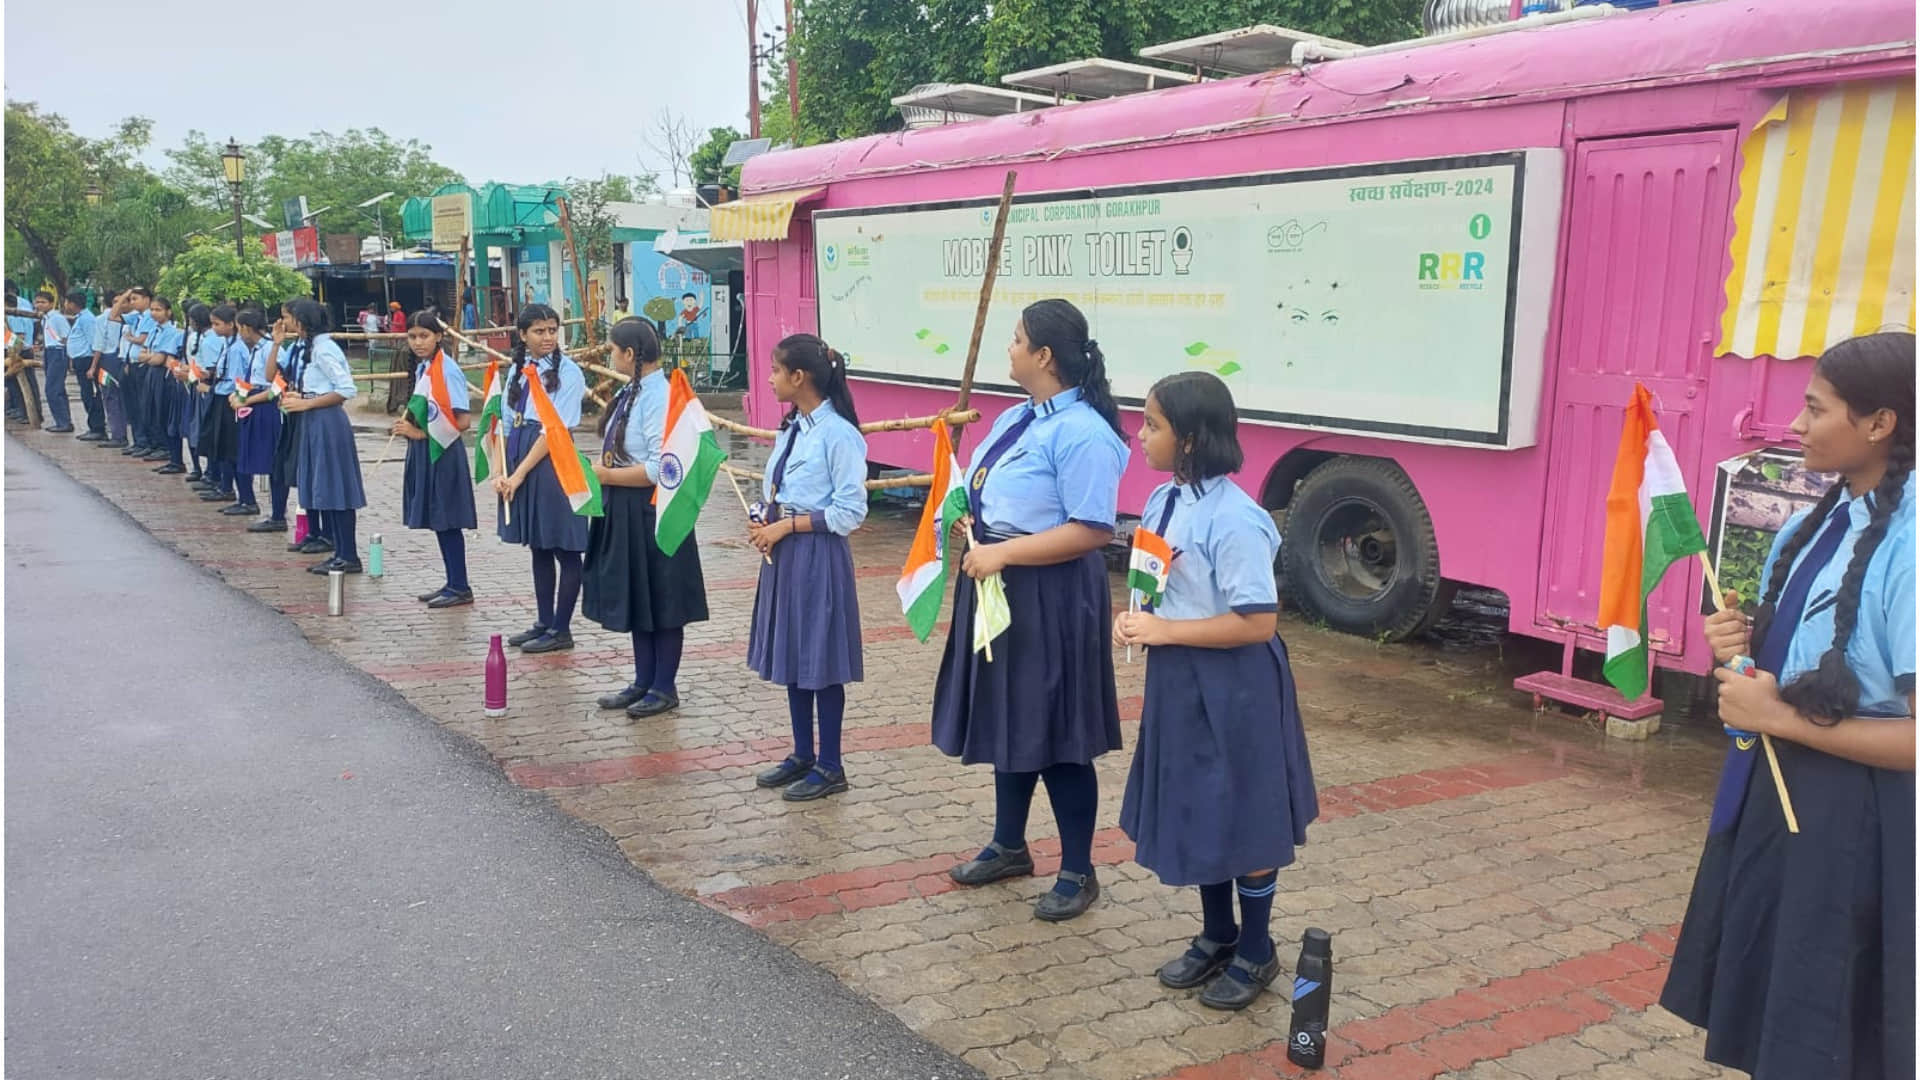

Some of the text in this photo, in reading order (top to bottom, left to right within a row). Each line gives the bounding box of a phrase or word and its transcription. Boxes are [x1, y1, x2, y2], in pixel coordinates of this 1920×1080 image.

[1044, 202, 1100, 221] CORPORATION
[1106, 199, 1161, 218] GORAKHPUR
[1023, 234, 1073, 277] PINK
[1085, 229, 1167, 277] TOILET
[1418, 251, 1485, 281] RRR
